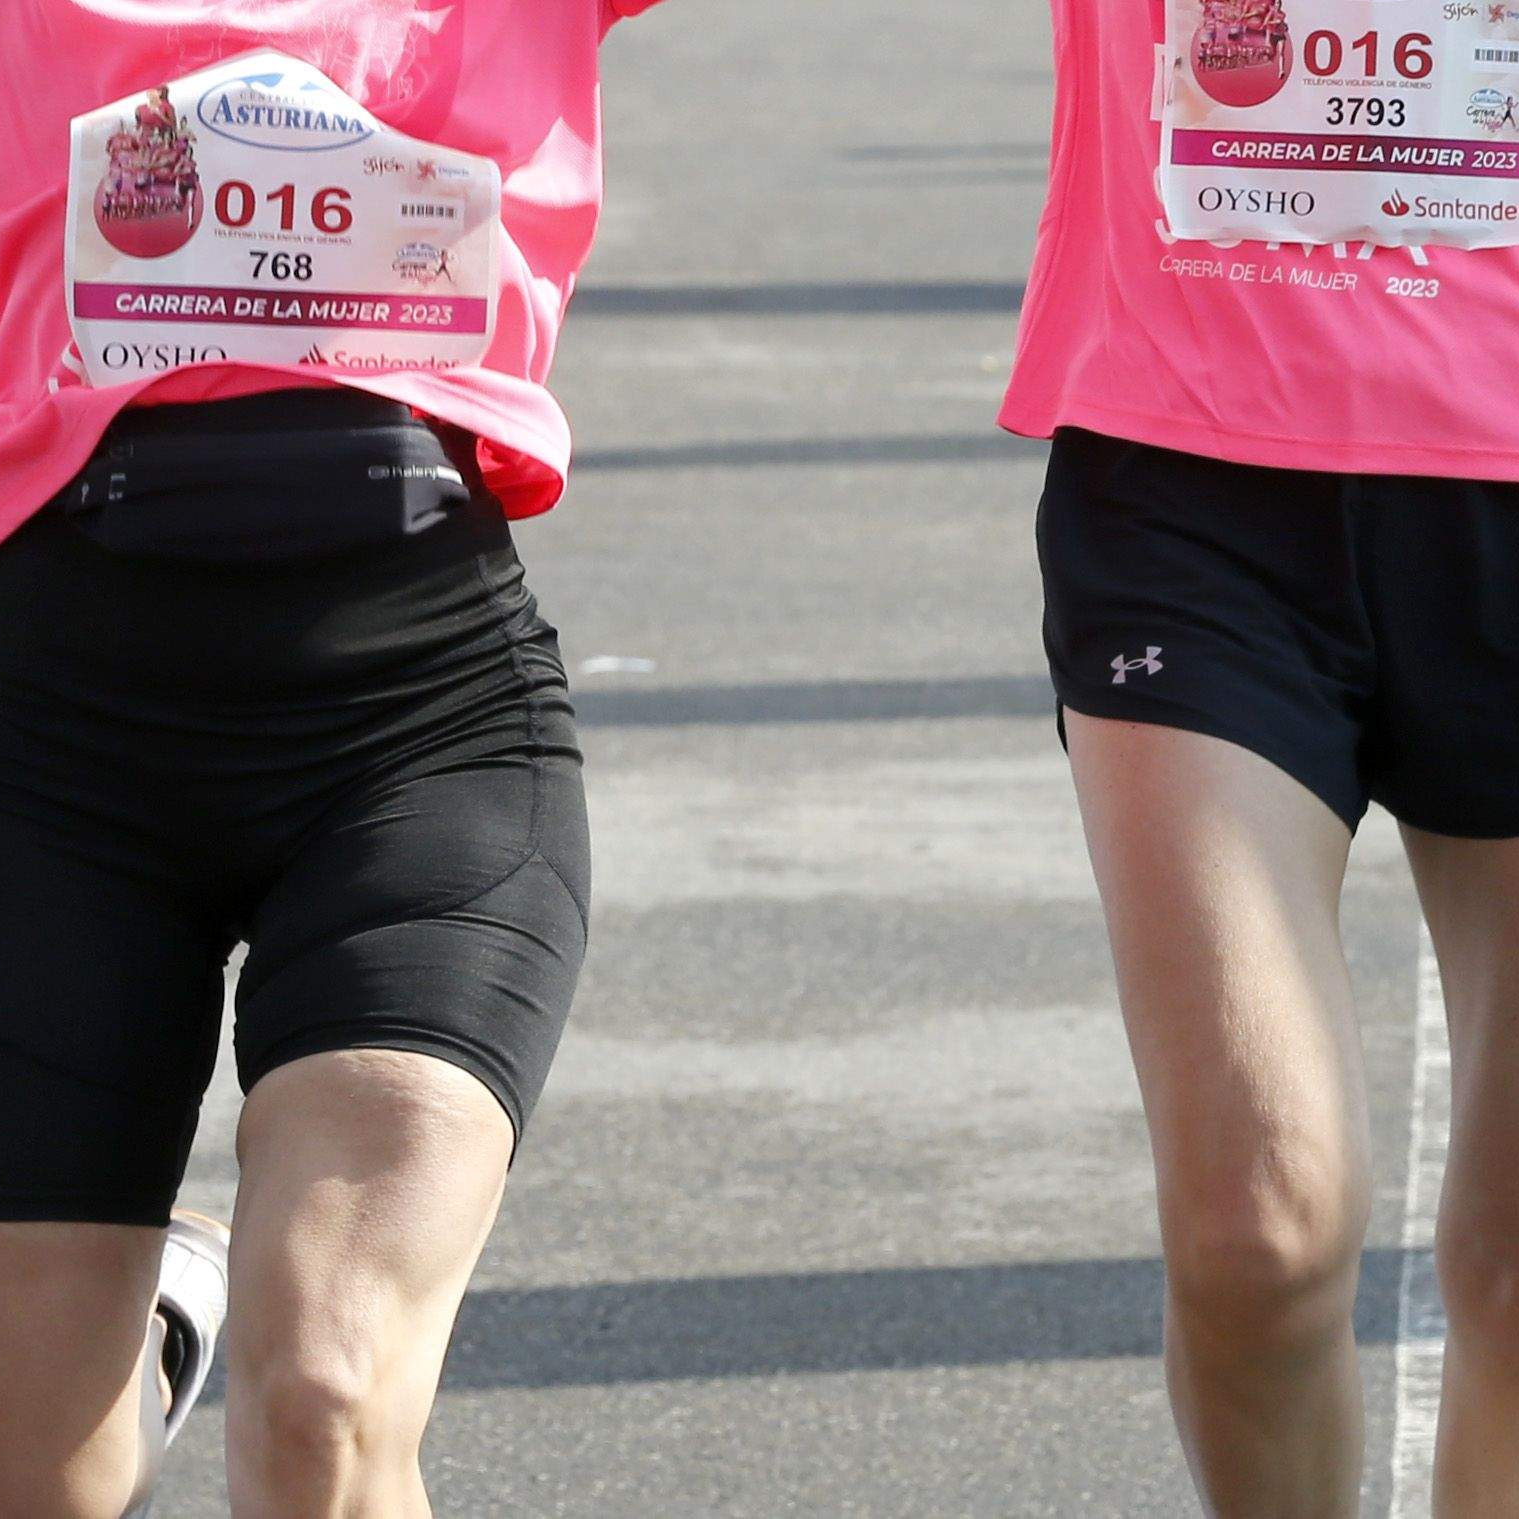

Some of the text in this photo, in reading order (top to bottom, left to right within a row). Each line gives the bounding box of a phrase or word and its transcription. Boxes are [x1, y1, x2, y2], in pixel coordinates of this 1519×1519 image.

[1443, 2, 1479, 21] gijón
[1303, 30, 1433, 80] 016
[1387, 80, 1398, 89] DE
[212, 93, 368, 135] ASTURIANA
[1326, 97, 1406, 128] 3793
[1211, 140, 1517, 170] CARRERA DE LA MUJER 2023
[214, 180, 354, 235] 016
[1197, 187, 1315, 217] OYSHO
[249, 250, 313, 281] 768
[1228, 263, 1255, 281] DE
[1260, 266, 1282, 284] LA
[1288, 267, 1359, 291] MUJER
[1385, 276, 1439, 299] 2023
[115, 292, 454, 326] CARRERA DE LA MUJER 2023
[102, 342, 228, 371] OYSHO
